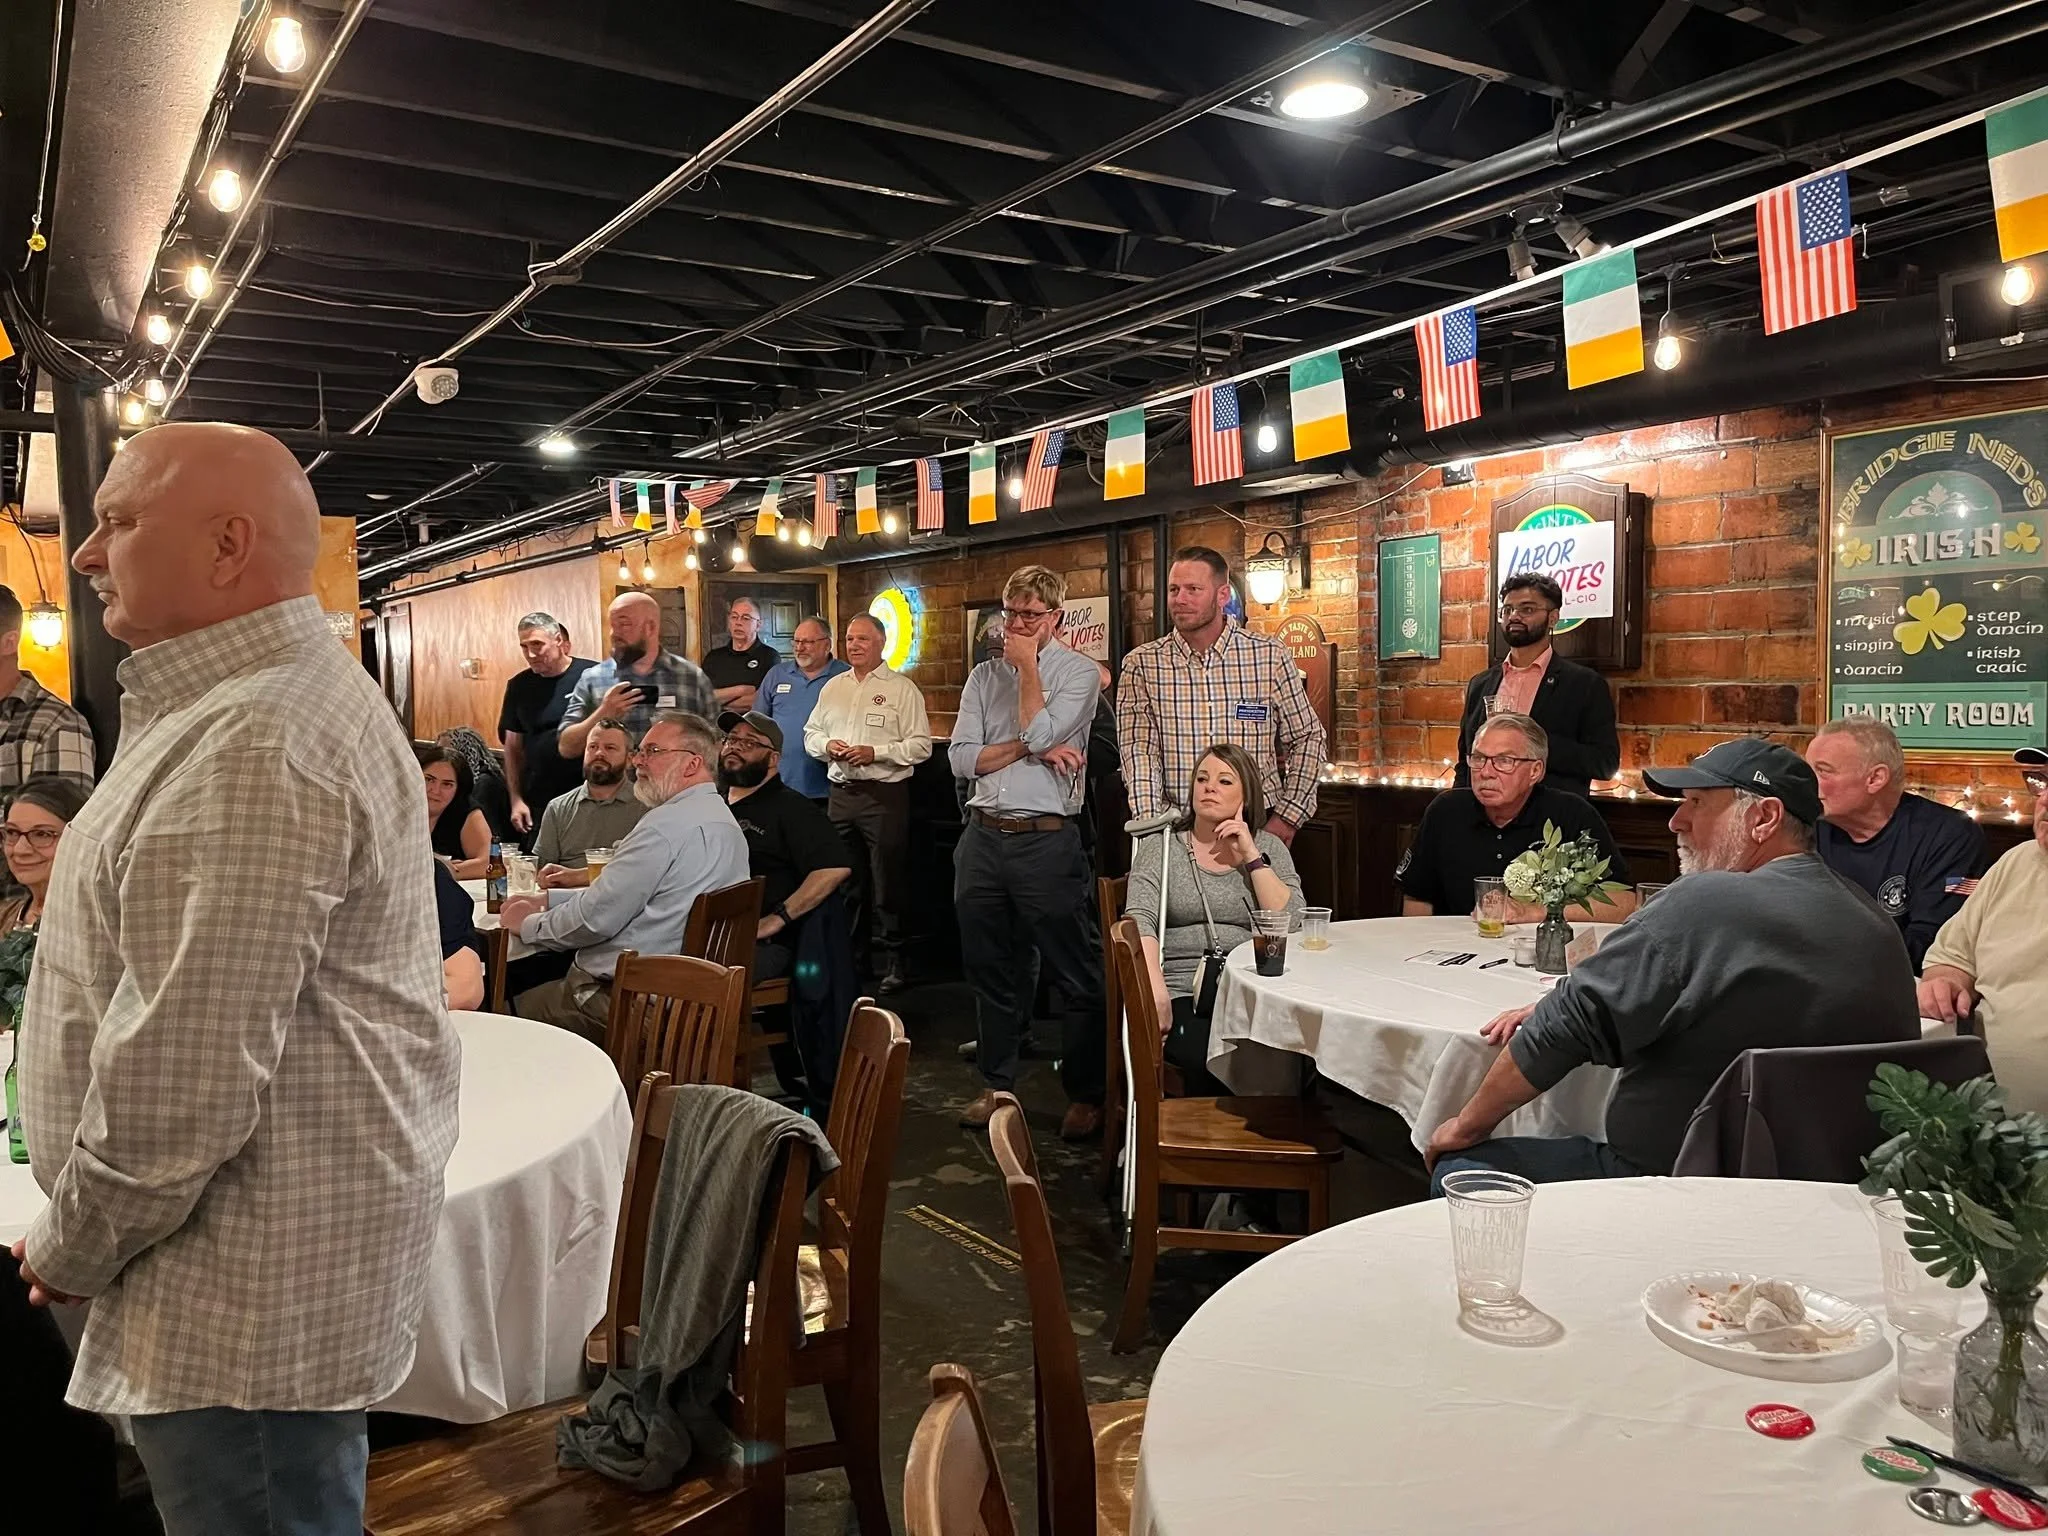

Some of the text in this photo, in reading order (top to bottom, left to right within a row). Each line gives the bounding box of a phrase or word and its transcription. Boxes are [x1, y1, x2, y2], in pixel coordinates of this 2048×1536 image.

[1838, 430, 1957, 525] BRIDGIE
[1877, 523, 2001, 566] IRISH
[1506, 538, 1575, 581] LABOR
[1549, 561, 1605, 592] OTES
[1565, 593, 1597, 605] L-CIO
[1845, 613, 1895, 627] music
[1977, 611, 2021, 624] step
[1288, 622, 1309, 633] TASTE
[1977, 621, 2044, 636] dancin
[1071, 622, 1106, 649] VOTES
[1287, 645, 1317, 659] LAND
[1844, 639, 1894, 653] singin
[1977, 646, 2021, 659] irish
[1844, 663, 1903, 676] dancin
[1976, 660, 2027, 673] craic
[1842, 702, 2035, 728] PARTY ROOM
